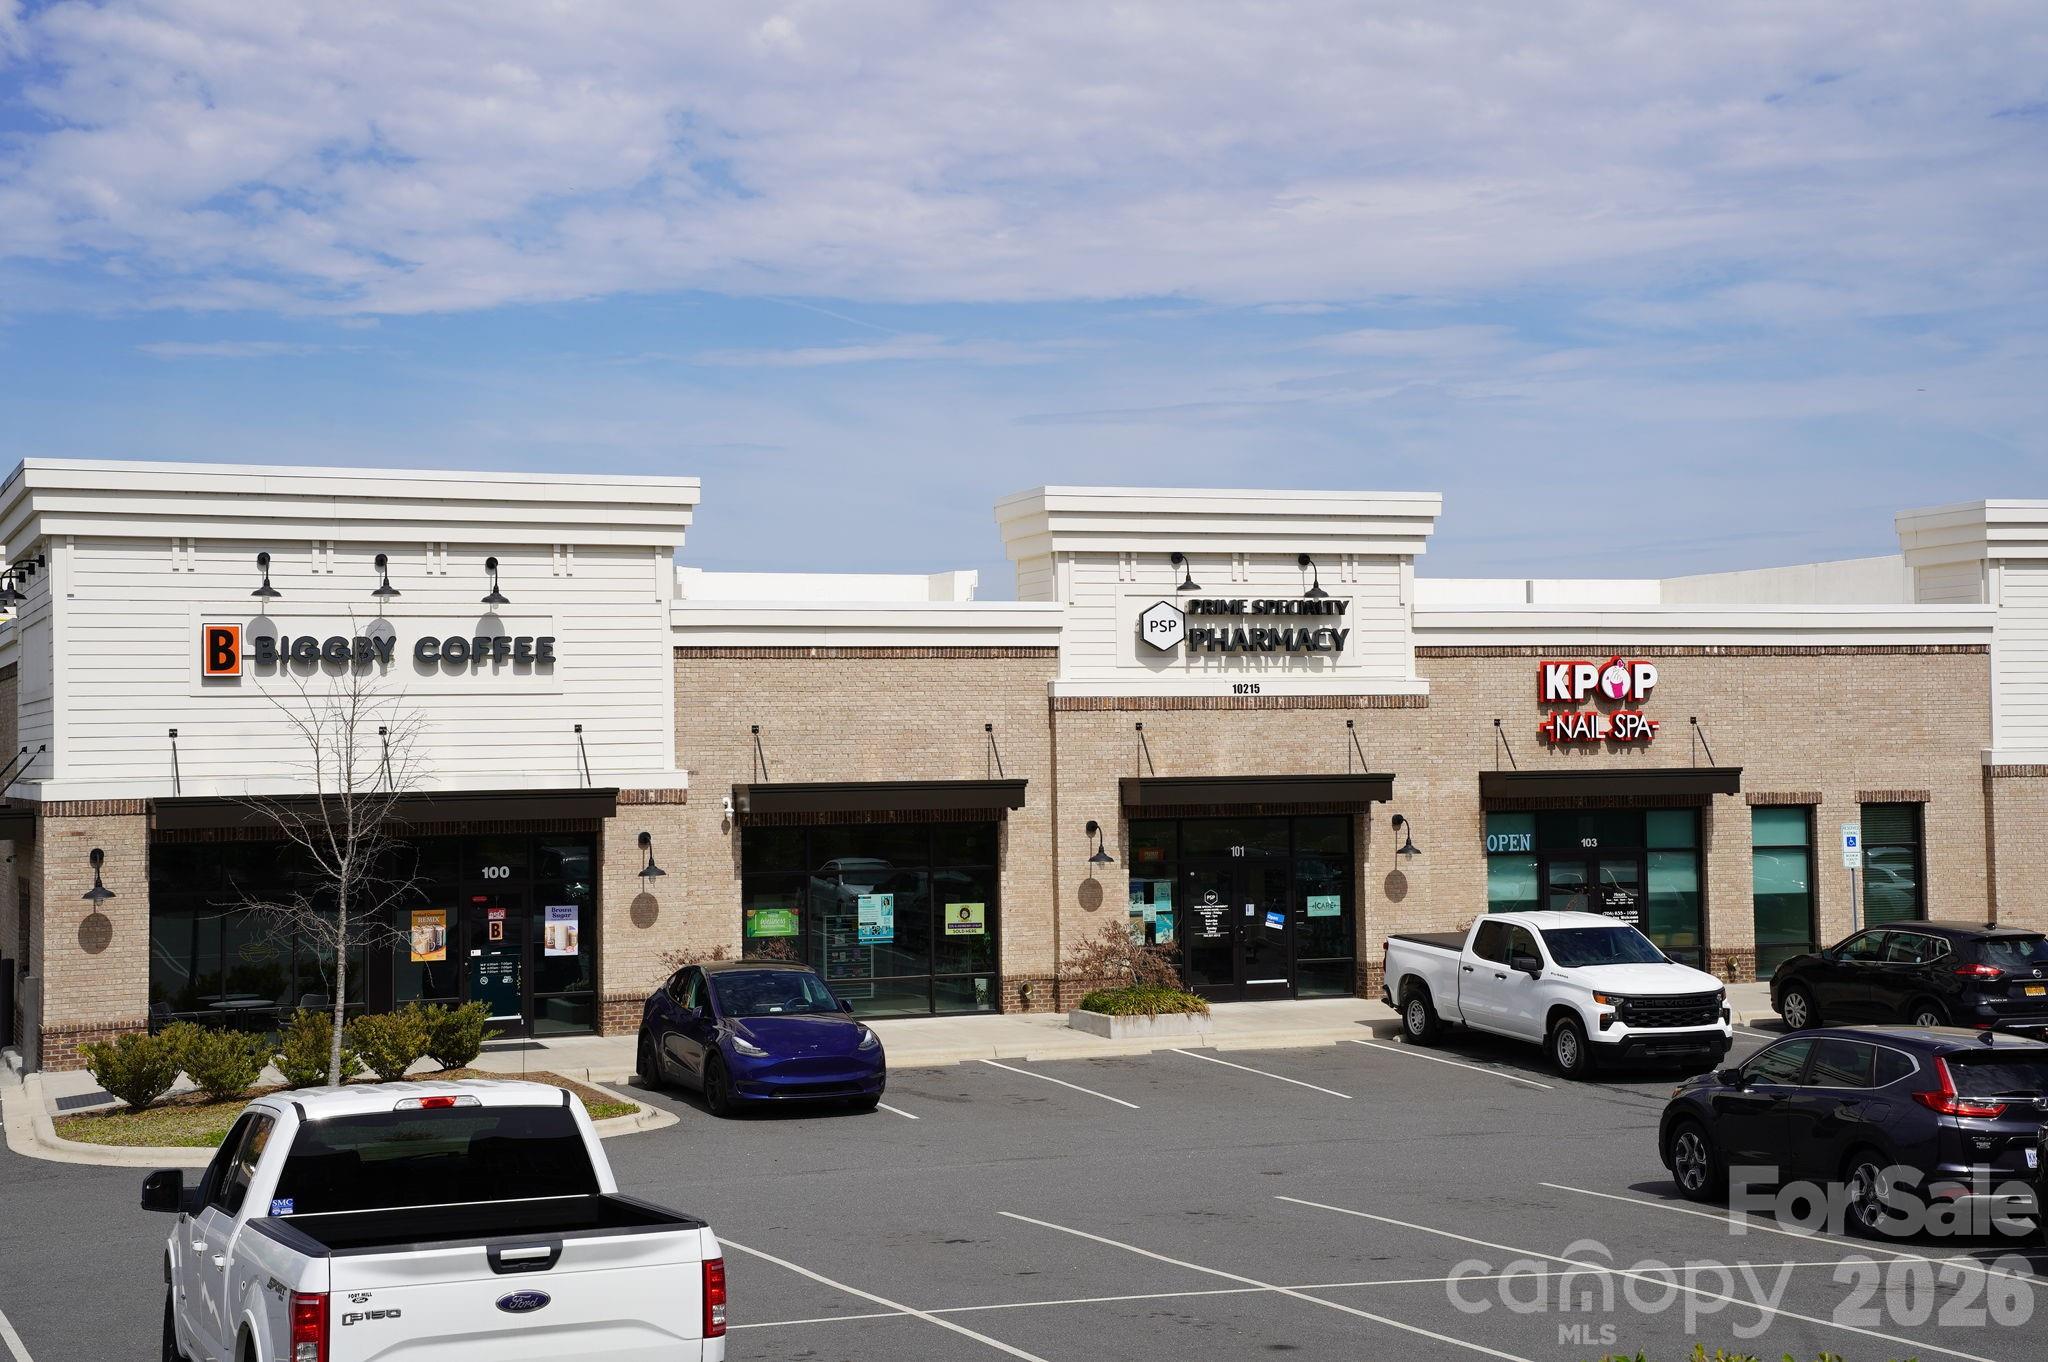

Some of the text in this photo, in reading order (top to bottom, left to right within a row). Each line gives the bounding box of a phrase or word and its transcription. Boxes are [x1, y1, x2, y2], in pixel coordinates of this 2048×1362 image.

[1188, 599, 1350, 616] PRIME SPECIALTY
[1149, 619, 1177, 633] PSP
[1188, 627, 1350, 652] PHARMACY
[209, 629, 235, 671] B
[254, 635, 556, 665] BIGGBY COFFEE
[1543, 660, 1659, 701] KPOP
[1232, 683, 1261, 695] 10215
[1556, 713, 1652, 739] NAIL SPA
[1486, 833, 1531, 852] OPEN
[1580, 838, 1598, 848] 103
[1230, 845, 1245, 857] 101
[481, 866, 510, 879] 100
[272, 1198, 294, 1207] SMC
[509, 1294, 539, 1309] Ford
